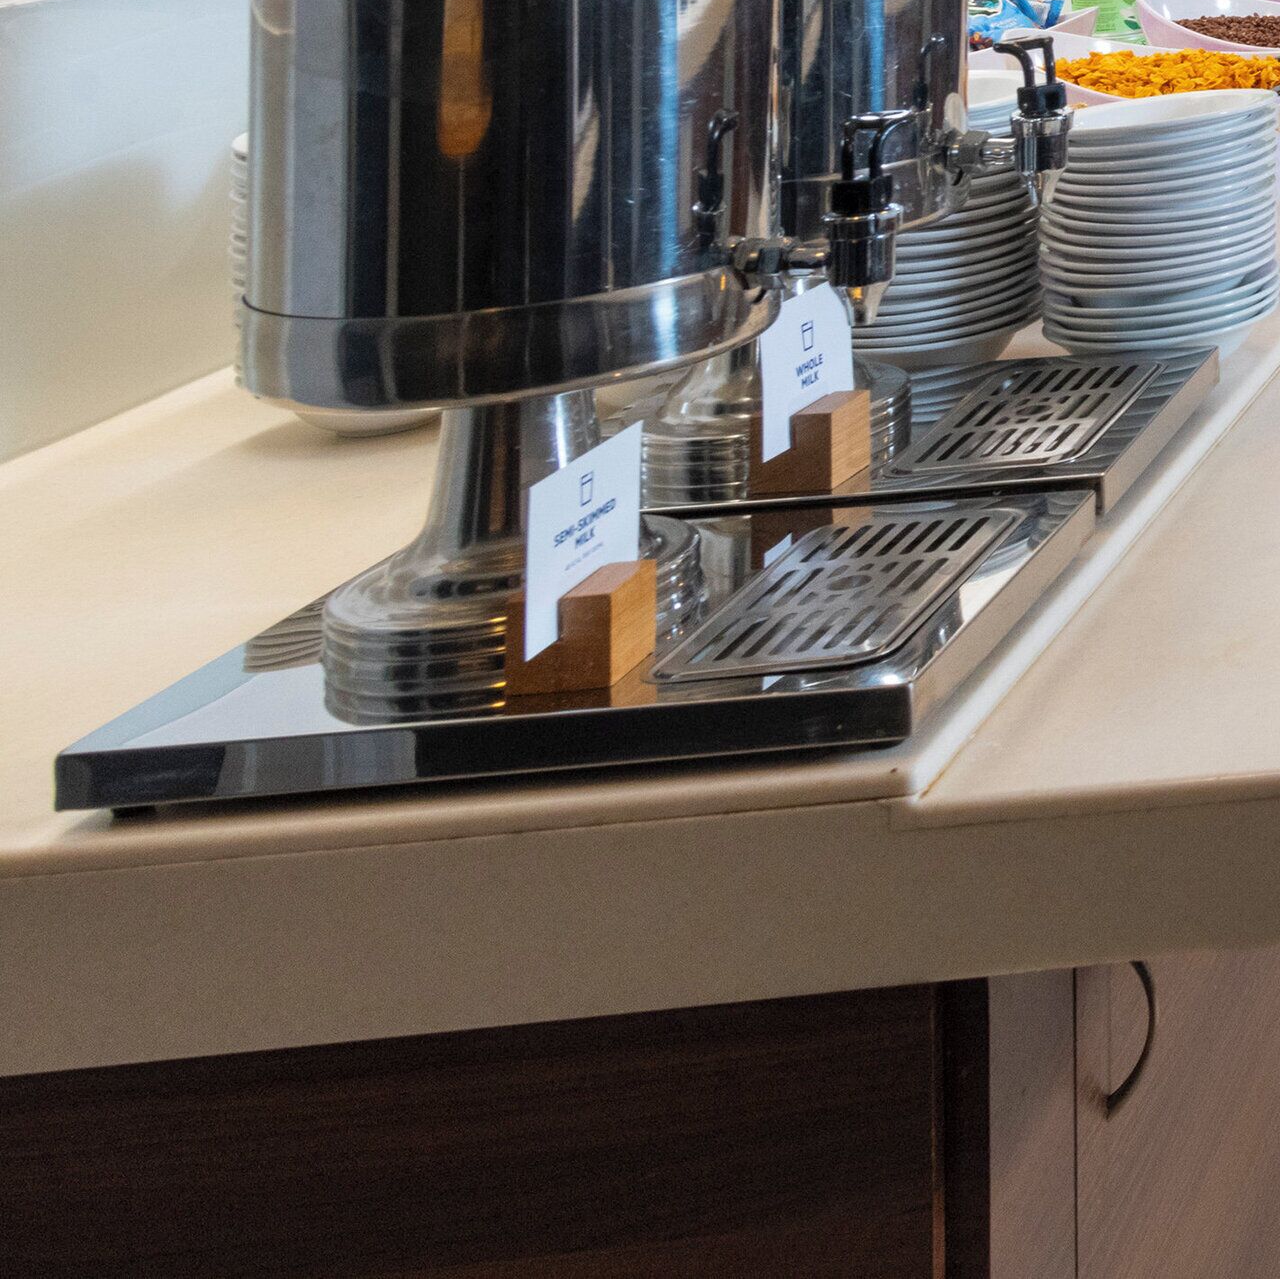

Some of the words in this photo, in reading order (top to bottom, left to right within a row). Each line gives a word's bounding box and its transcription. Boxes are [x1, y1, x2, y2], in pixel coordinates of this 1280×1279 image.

[795, 353, 824, 377] WHOLE
[801, 370, 820, 390] MILK
[553, 497, 617, 548] SEMI-SKIMMED
[574, 525, 596, 549] MILK
